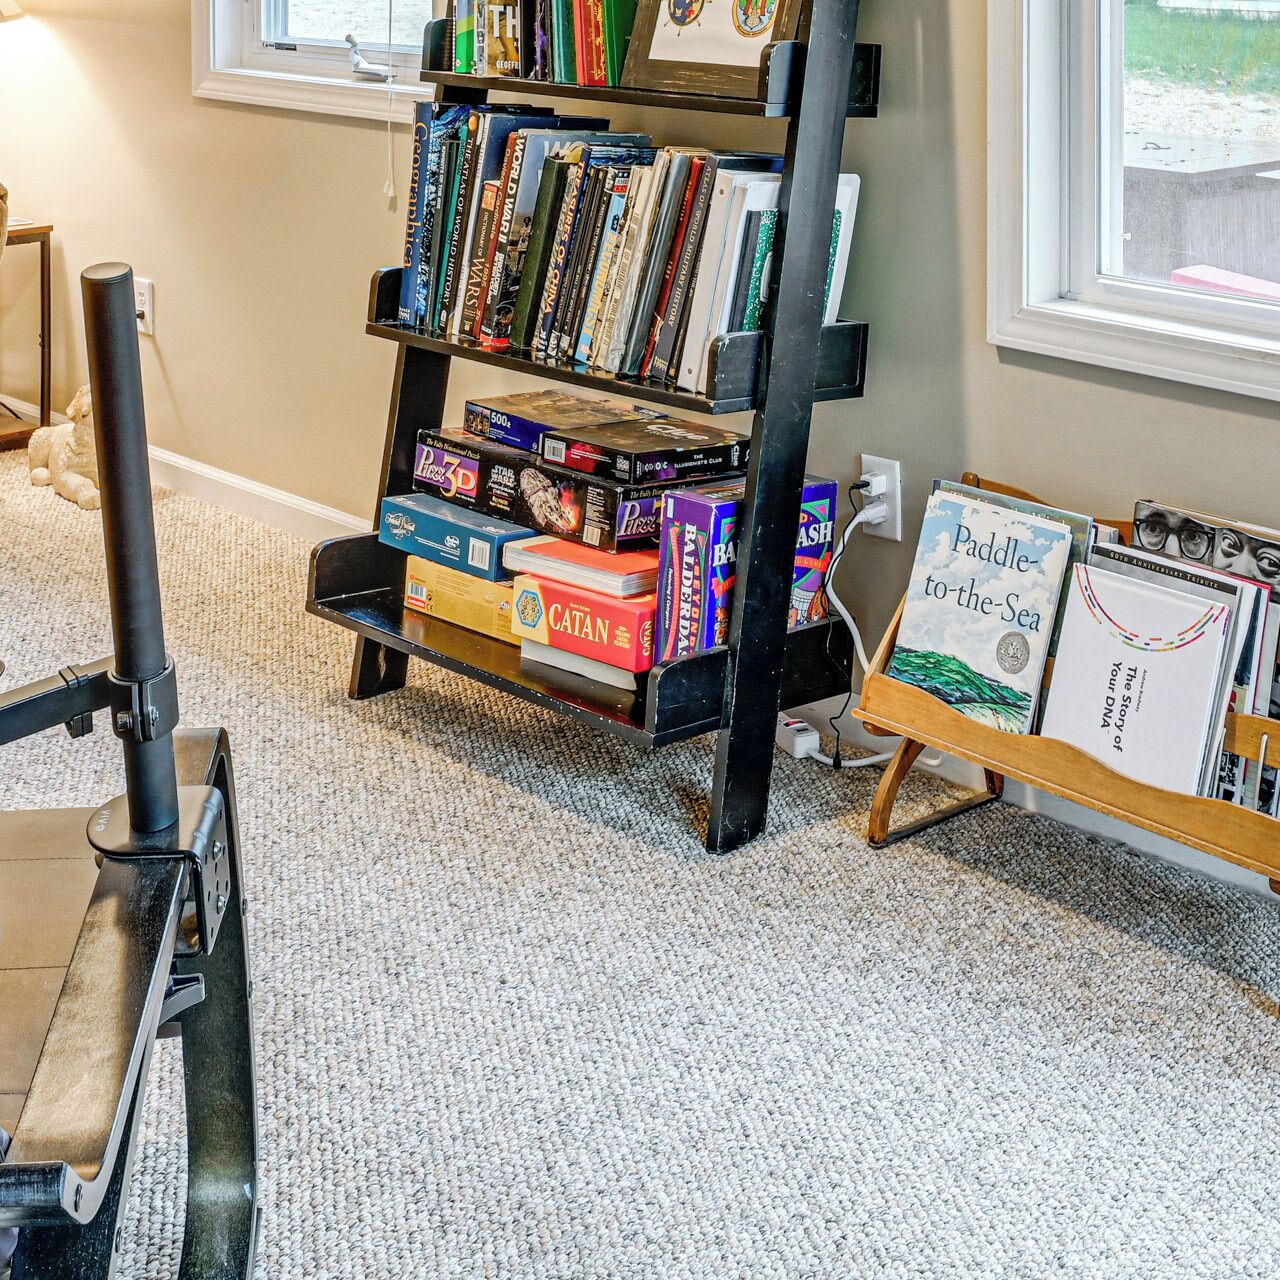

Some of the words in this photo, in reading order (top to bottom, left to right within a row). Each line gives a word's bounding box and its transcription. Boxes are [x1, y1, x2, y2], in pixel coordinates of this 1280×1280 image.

[463, 137, 474, 159] THE
[458, 160, 470, 195] ATLAS
[506, 137, 525, 194] WORLD
[700, 165, 713, 193] ATLAS
[404, 121, 429, 268] Geographica
[455, 197, 464, 212] OF
[561, 159, 585, 241] TREASURES
[697, 194, 706, 206] OF
[478, 211, 489, 247] DICTIONARY
[489, 190, 503, 239] Cardinals
[498, 197, 514, 234] WAR
[688, 209, 702, 243] WORLD
[449, 215, 462, 255] WORLD
[476, 247, 483, 256] OF
[497, 233, 507, 243] II
[491, 250, 500, 274] PETER
[555, 244, 565, 265] OF
[676, 243, 694, 286] MILITARY
[441, 258, 455, 305] HISTORY
[464, 255, 485, 307] WARS
[480, 262, 490, 287] 1995
[485, 274, 496, 305] YOUNG
[492, 252, 505, 294] BRIGADIER
[543, 268, 560, 314] CHINA
[666, 286, 683, 327] HISTORY
[490, 411, 507, 426] 500
[647, 424, 709, 440] Clue
[433, 441, 444, 449] Fully
[444, 443, 467, 455] Dimensional
[467, 450, 480, 460] Puzzle
[674, 460, 708, 468] ILLUSIONISTS
[414, 445, 445, 483] Puzz
[440, 453, 476, 497] 3D
[490, 472, 514, 487] WARS
[492, 465, 514, 477] STAR
[630, 491, 639, 499] The
[640, 490, 651, 499] Fully
[618, 502, 655, 536] Puzz
[796, 521, 833, 548] ASH
[952, 523, 1039, 573] Paddle-
[1109, 551, 1130, 563] 60TH
[1132, 558, 1184, 579] ANNIVERSARY
[1186, 573, 1219, 589] TRIBUTE
[924, 575, 1041, 633] to-the-Sea
[548, 603, 610, 646] CATAN
[642, 620, 652, 656] CATAN
[1106, 661, 1123, 693] Your
[1125, 666, 1138, 692] The
[1100, 696, 1116, 730] DNA
[1119, 694, 1133, 732] Story
[1113, 736, 1123, 753] of
